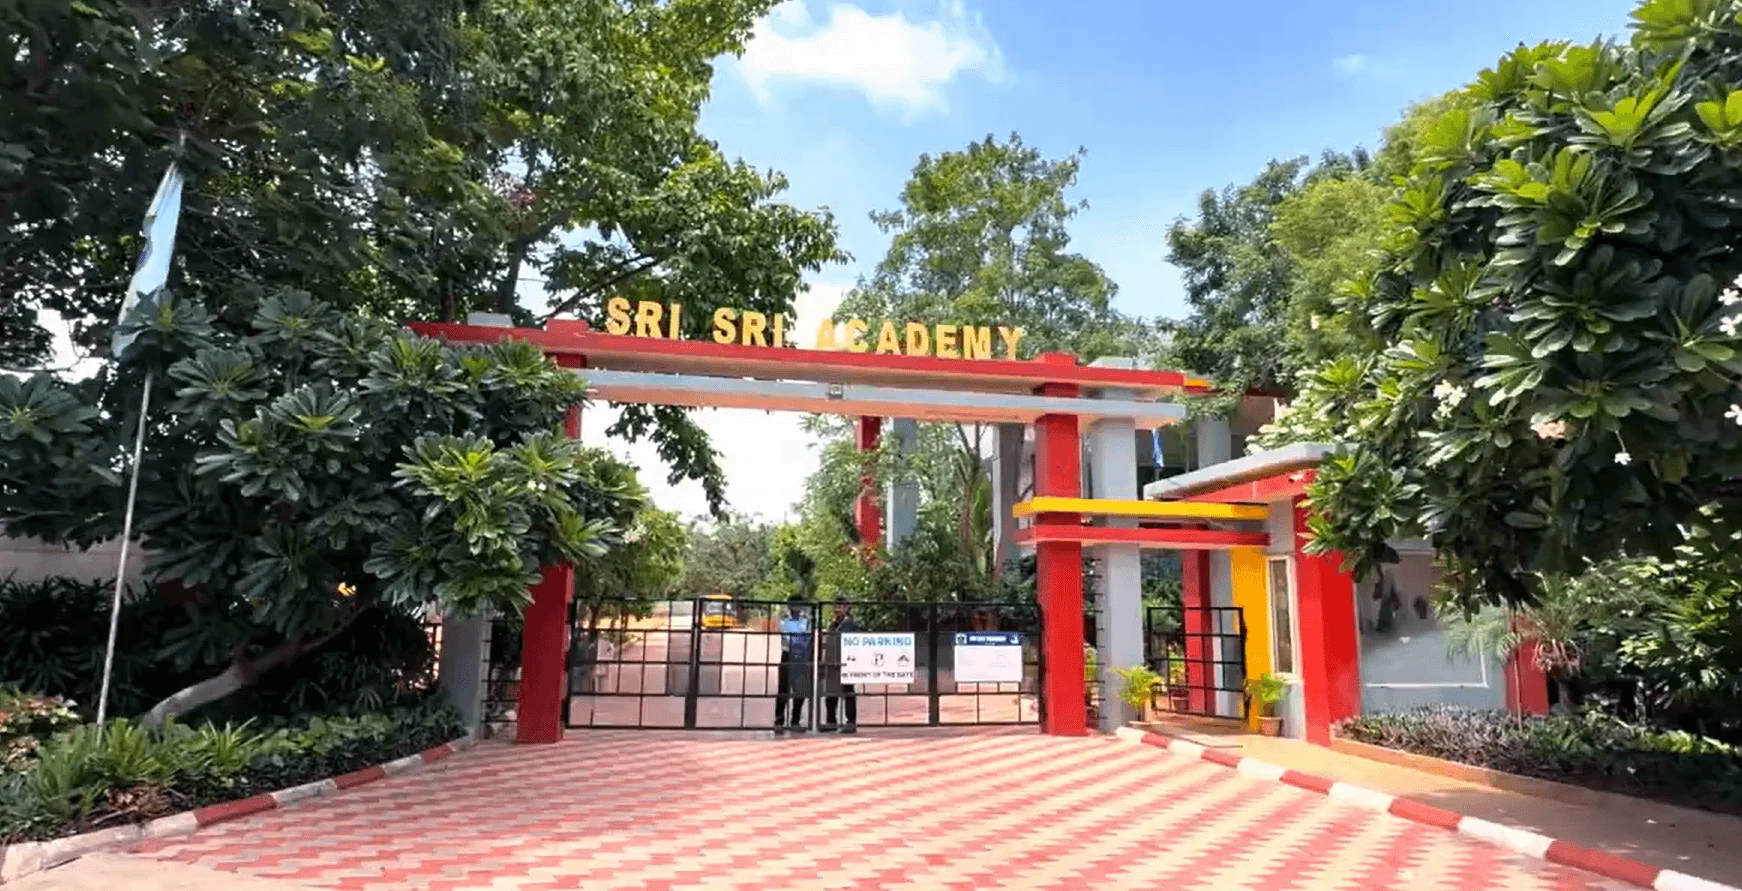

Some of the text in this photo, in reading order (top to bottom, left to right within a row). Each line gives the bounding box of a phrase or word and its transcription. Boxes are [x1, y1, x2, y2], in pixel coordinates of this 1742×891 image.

[606, 297, 1021, 361] SRI SRI ACADEMY
[843, 636, 860, 647] NO
